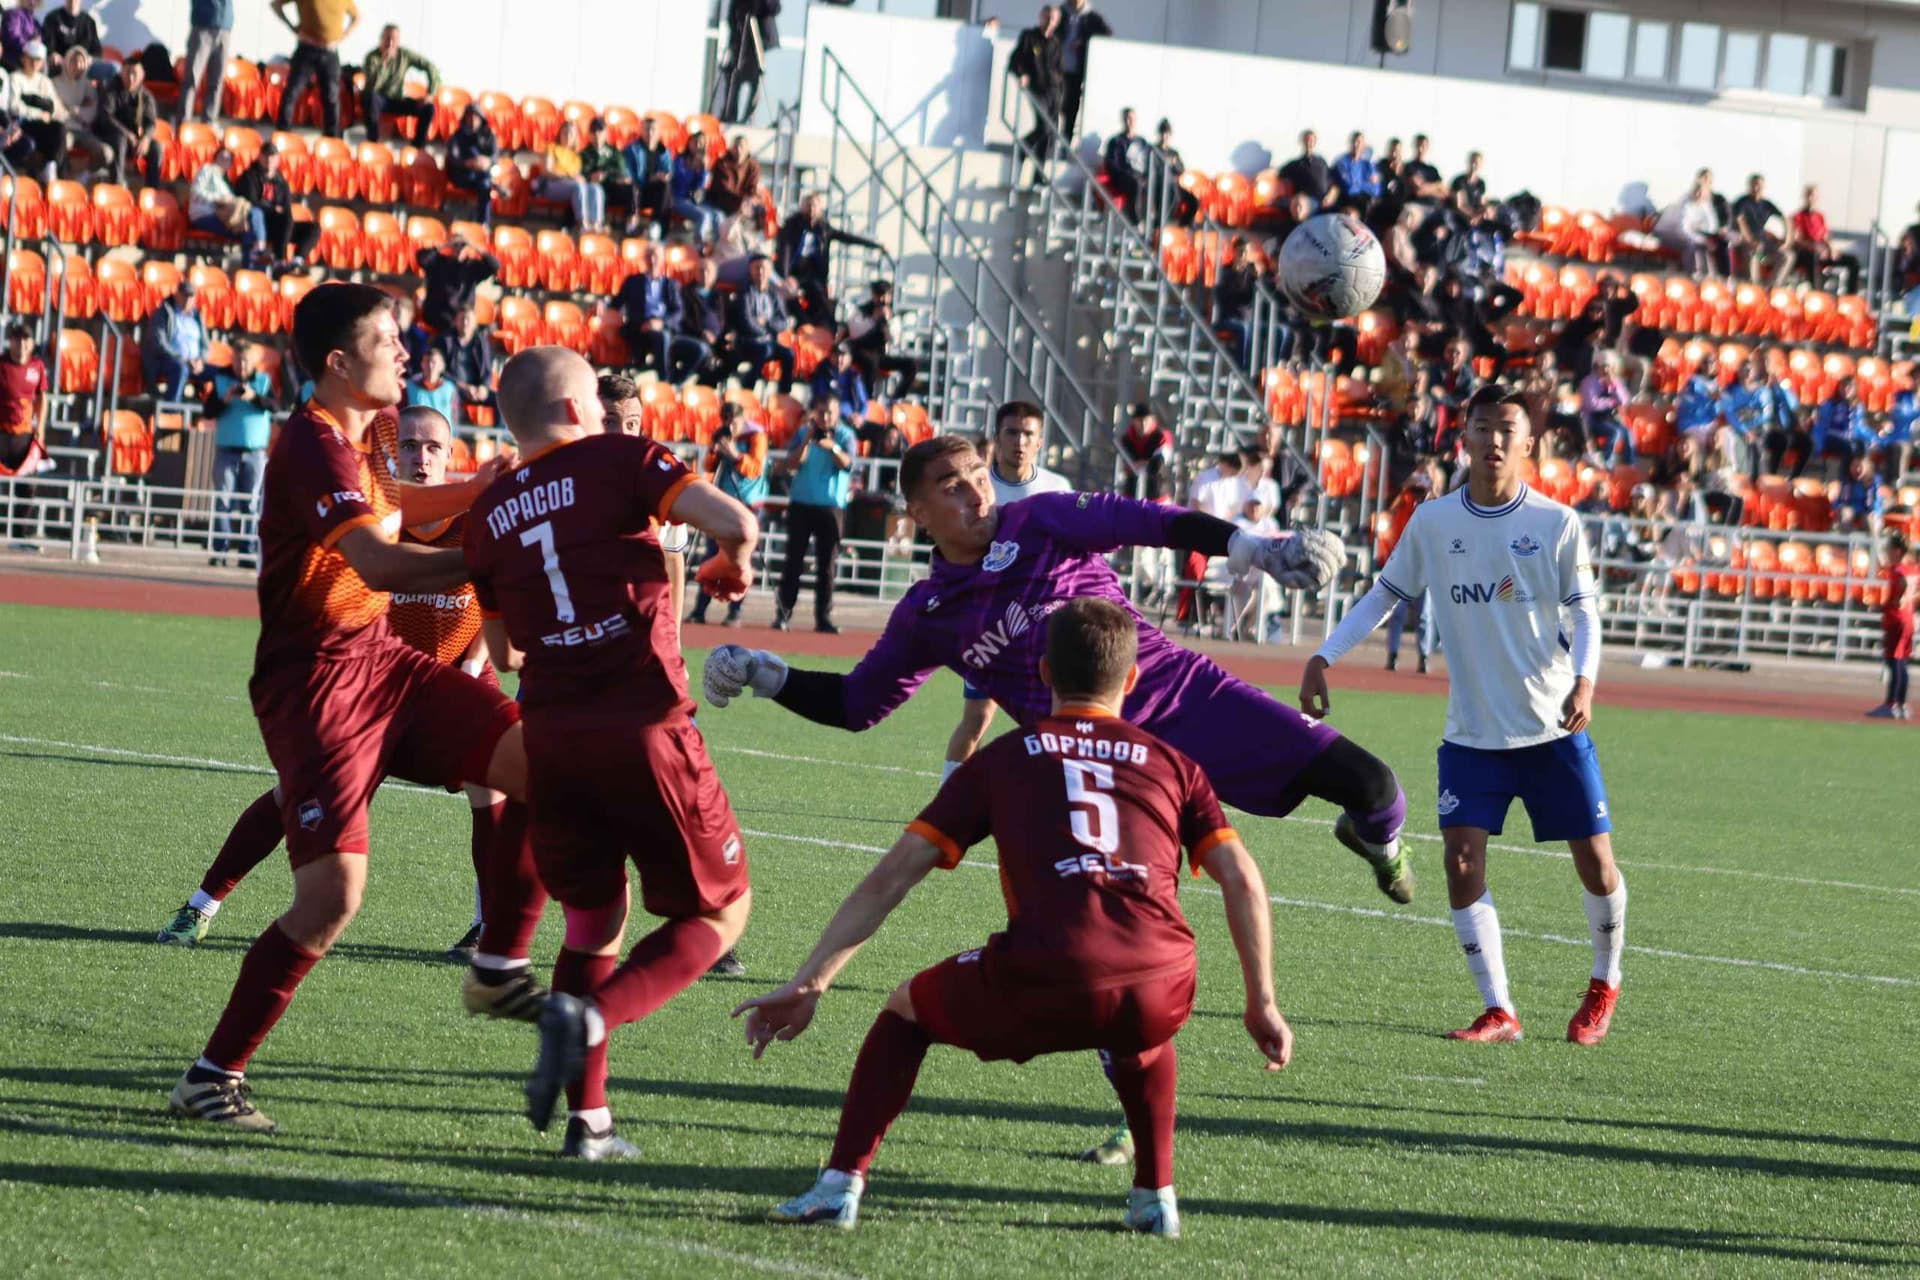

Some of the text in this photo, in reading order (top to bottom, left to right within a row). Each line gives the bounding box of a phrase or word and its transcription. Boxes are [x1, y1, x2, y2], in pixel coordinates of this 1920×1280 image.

[486, 476, 576, 540] ТАРАСОВ
[519, 520, 575, 624] 7
[1450, 582, 1497, 604] GNV
[962, 619, 1009, 669] GNV
[1062, 758, 1120, 854] 5
